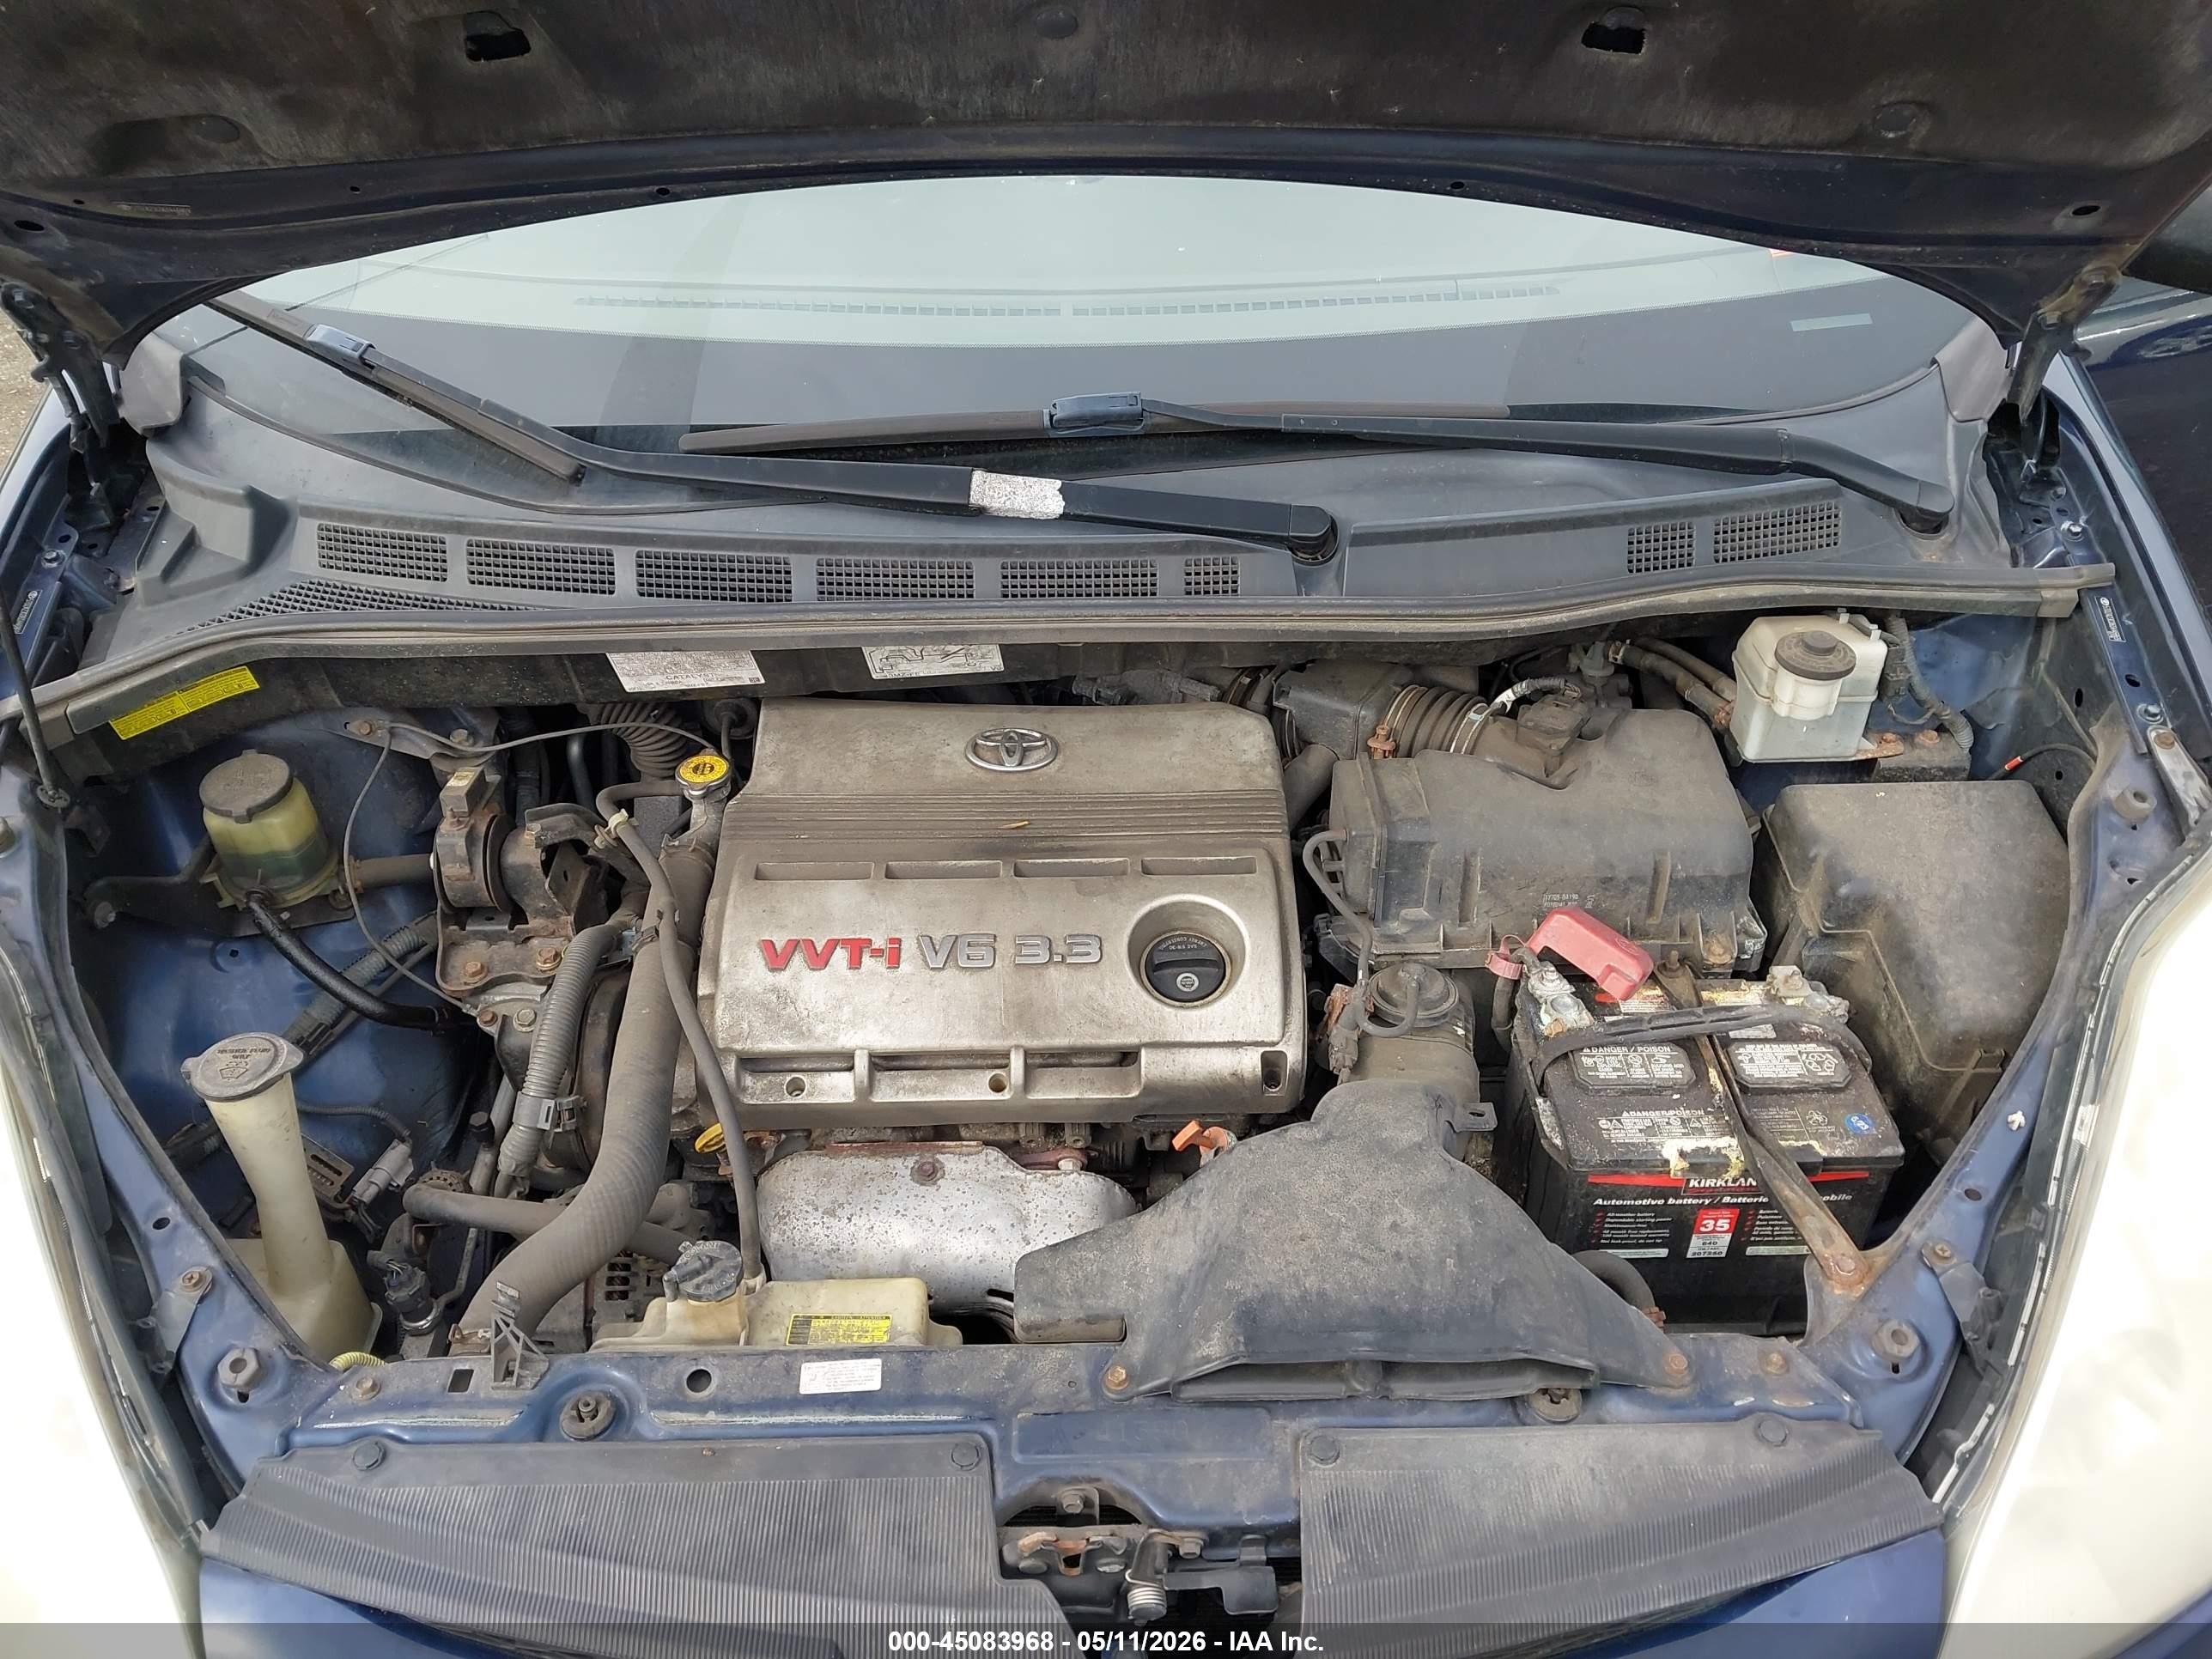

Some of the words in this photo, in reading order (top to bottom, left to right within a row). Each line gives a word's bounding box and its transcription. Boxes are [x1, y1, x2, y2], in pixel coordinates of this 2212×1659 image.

[665, 672, 714, 681] CATALYST
[759, 937, 902, 970] VVT-i
[919, 932, 997, 969] V6
[1014, 934, 1103, 965] 3.3
[1688, 1177, 1758, 1188] KIRKLAN
[1667, 1196, 1712, 1206] battery
[1721, 1194, 1770, 1203] Batterie
[1699, 1218, 1731, 1232] 35
